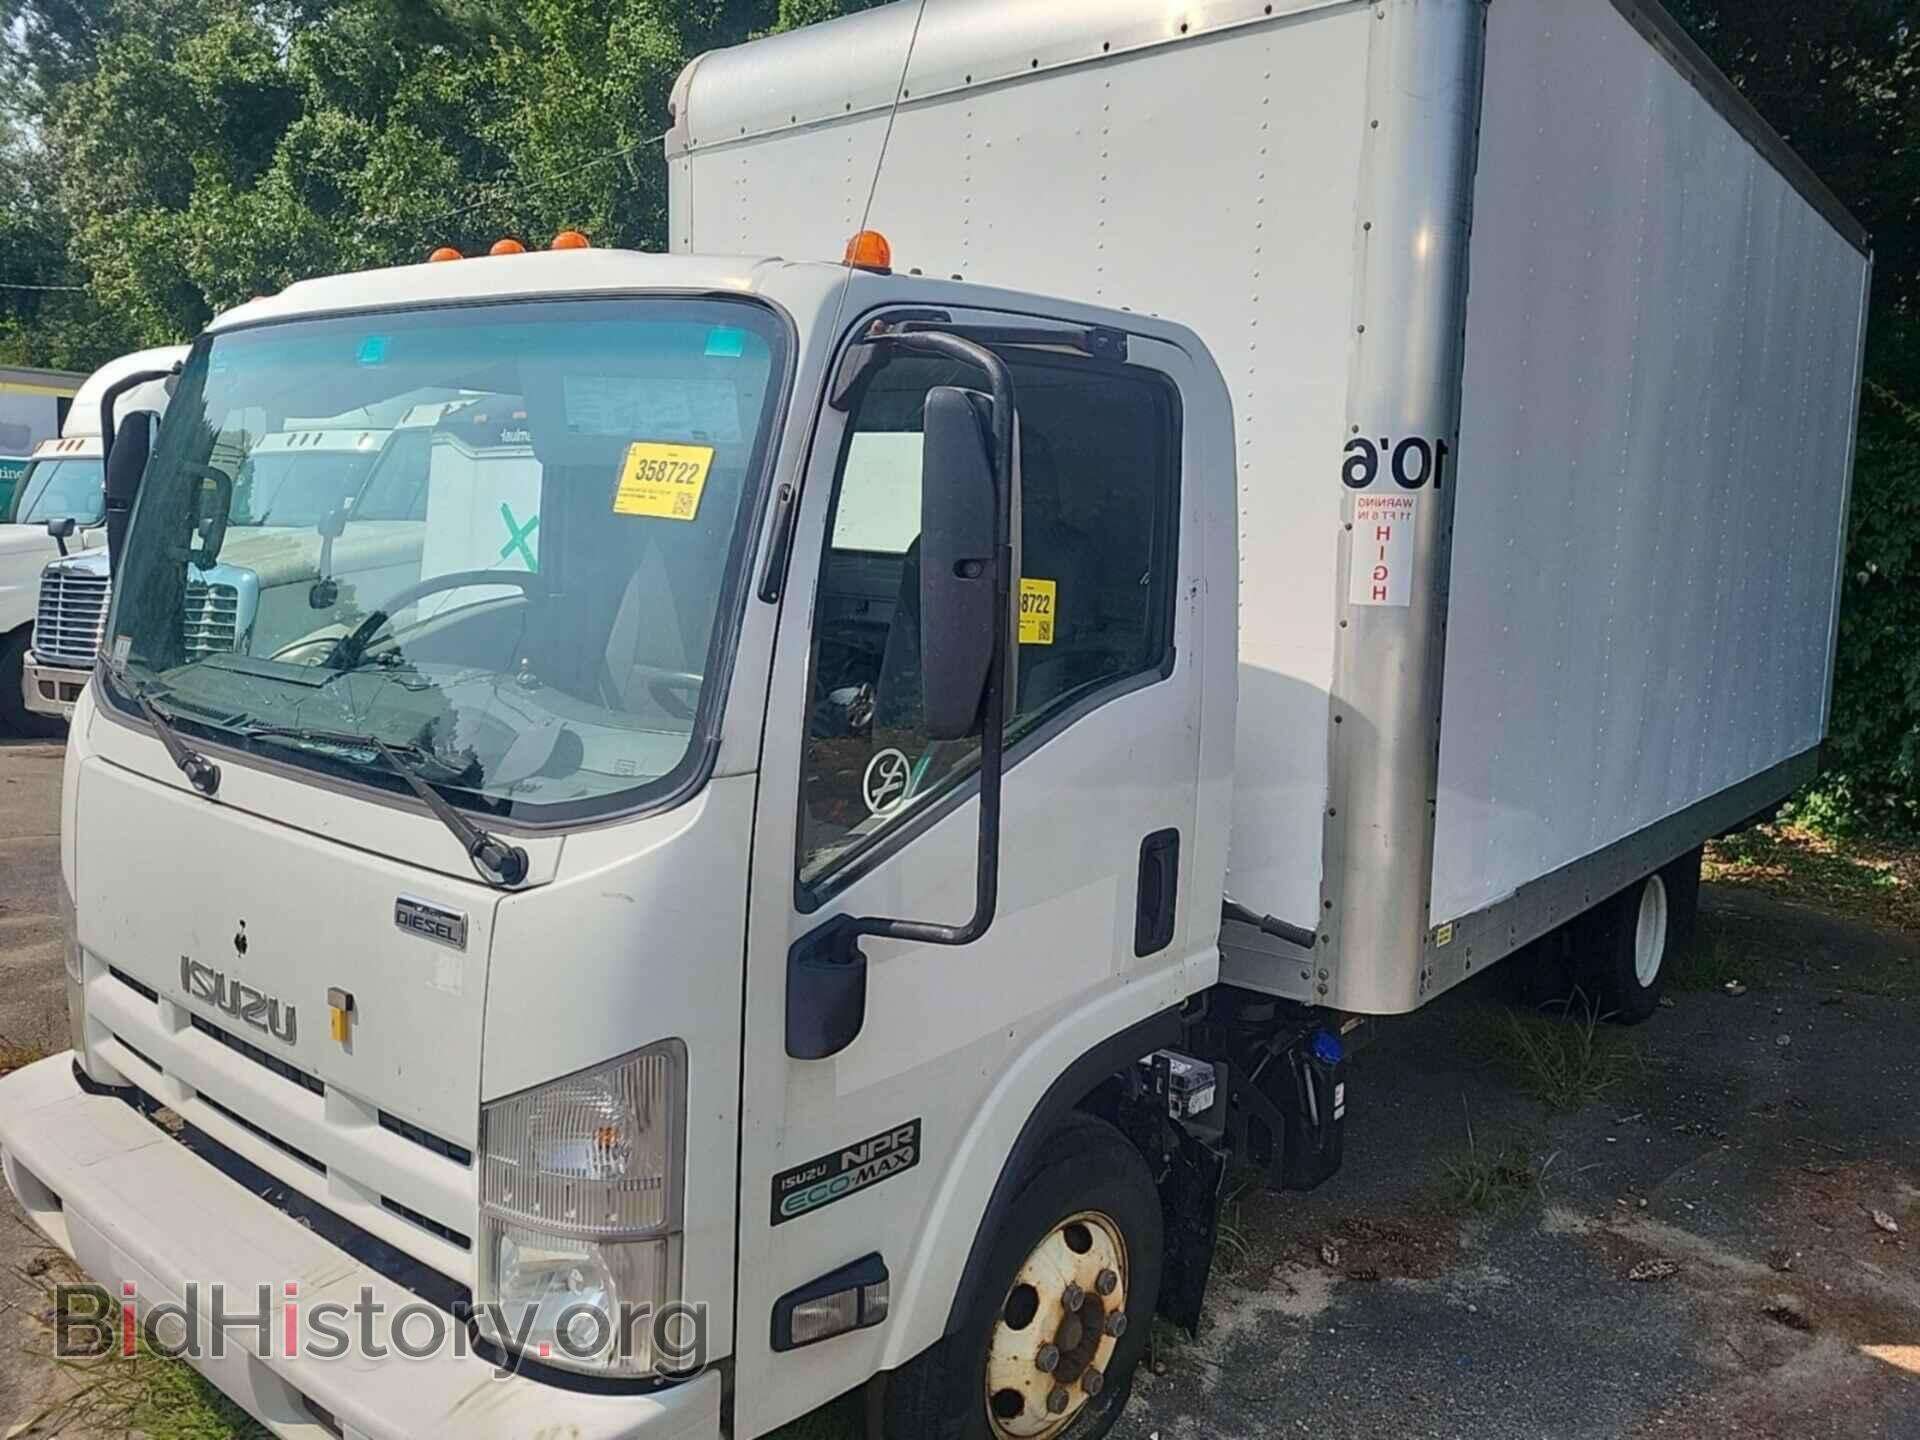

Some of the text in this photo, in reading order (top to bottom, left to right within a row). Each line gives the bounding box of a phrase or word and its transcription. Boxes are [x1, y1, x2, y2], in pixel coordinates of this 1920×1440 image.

[635, 459, 700, 485] 358722
[396, 910, 458, 942] DIESEL
[180, 955, 297, 1046] ISUZU
[781, 1125, 914, 1191] ISUZU NPR
